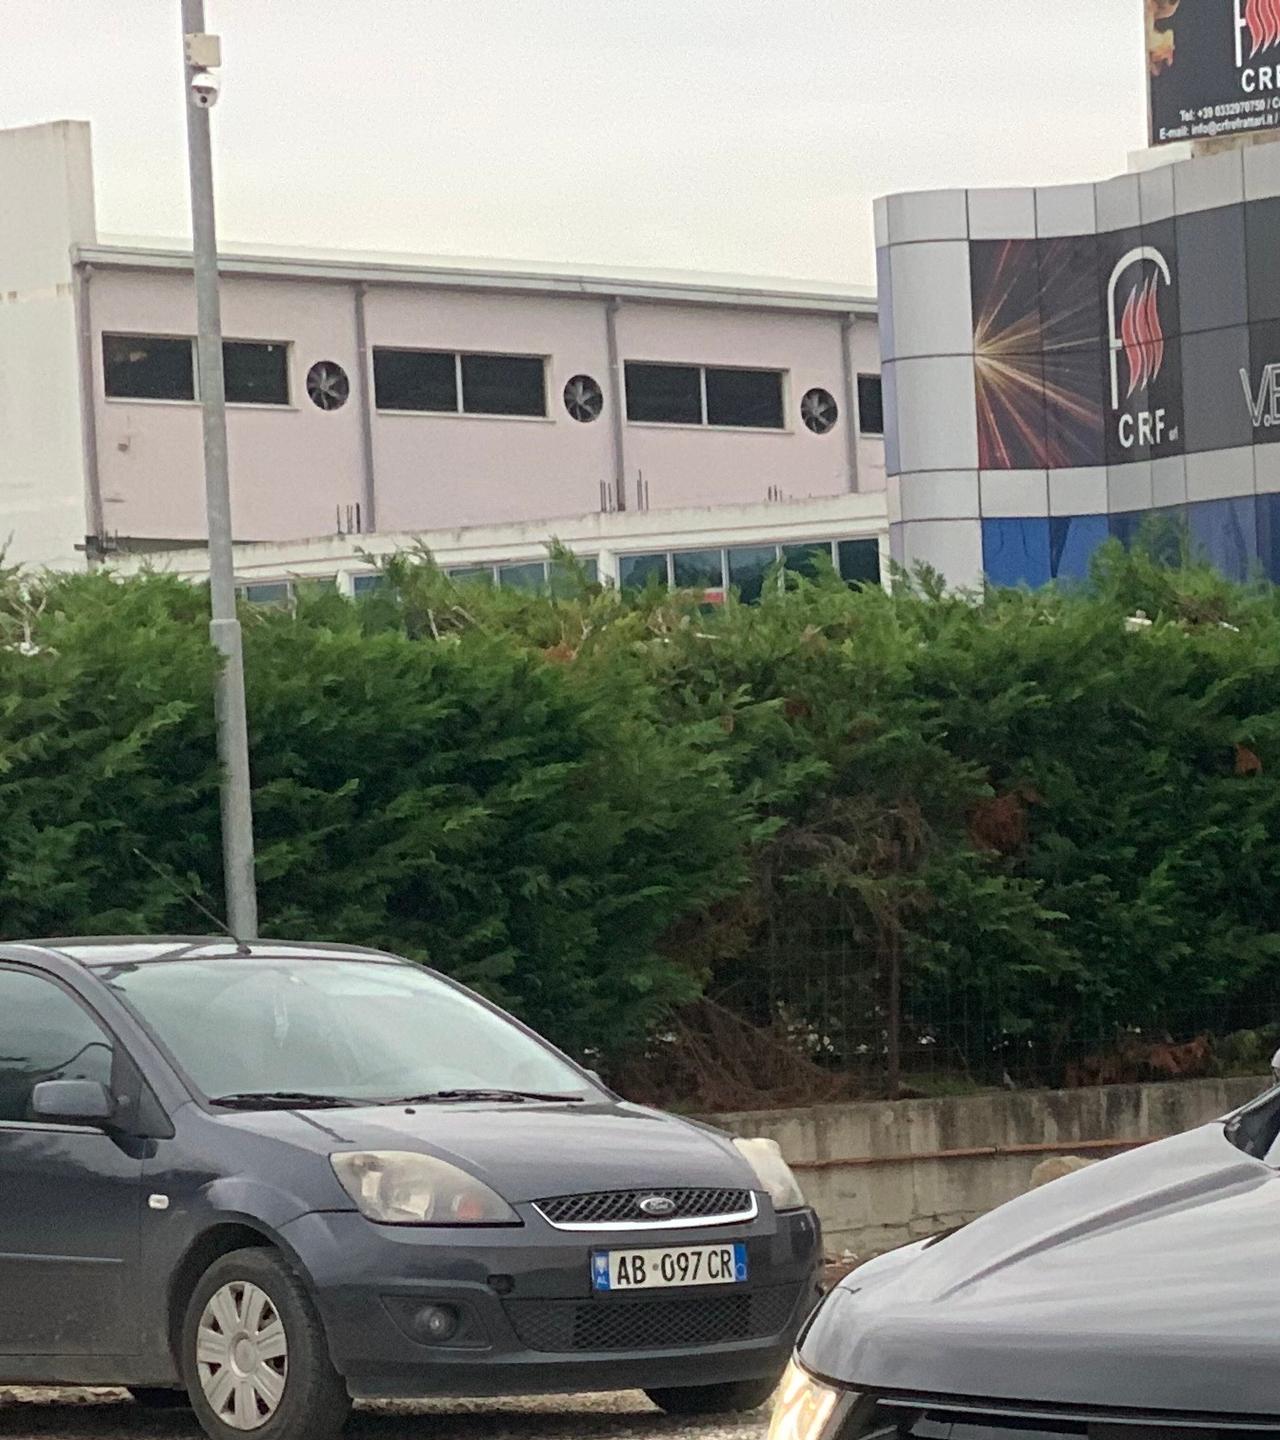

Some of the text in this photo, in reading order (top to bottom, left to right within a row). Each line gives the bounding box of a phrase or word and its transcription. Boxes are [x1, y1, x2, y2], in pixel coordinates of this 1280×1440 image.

[1197, 107, 1213, 119] +39
[1118, 408, 1165, 448] CRF
[617, 1255, 647, 1285] AB
